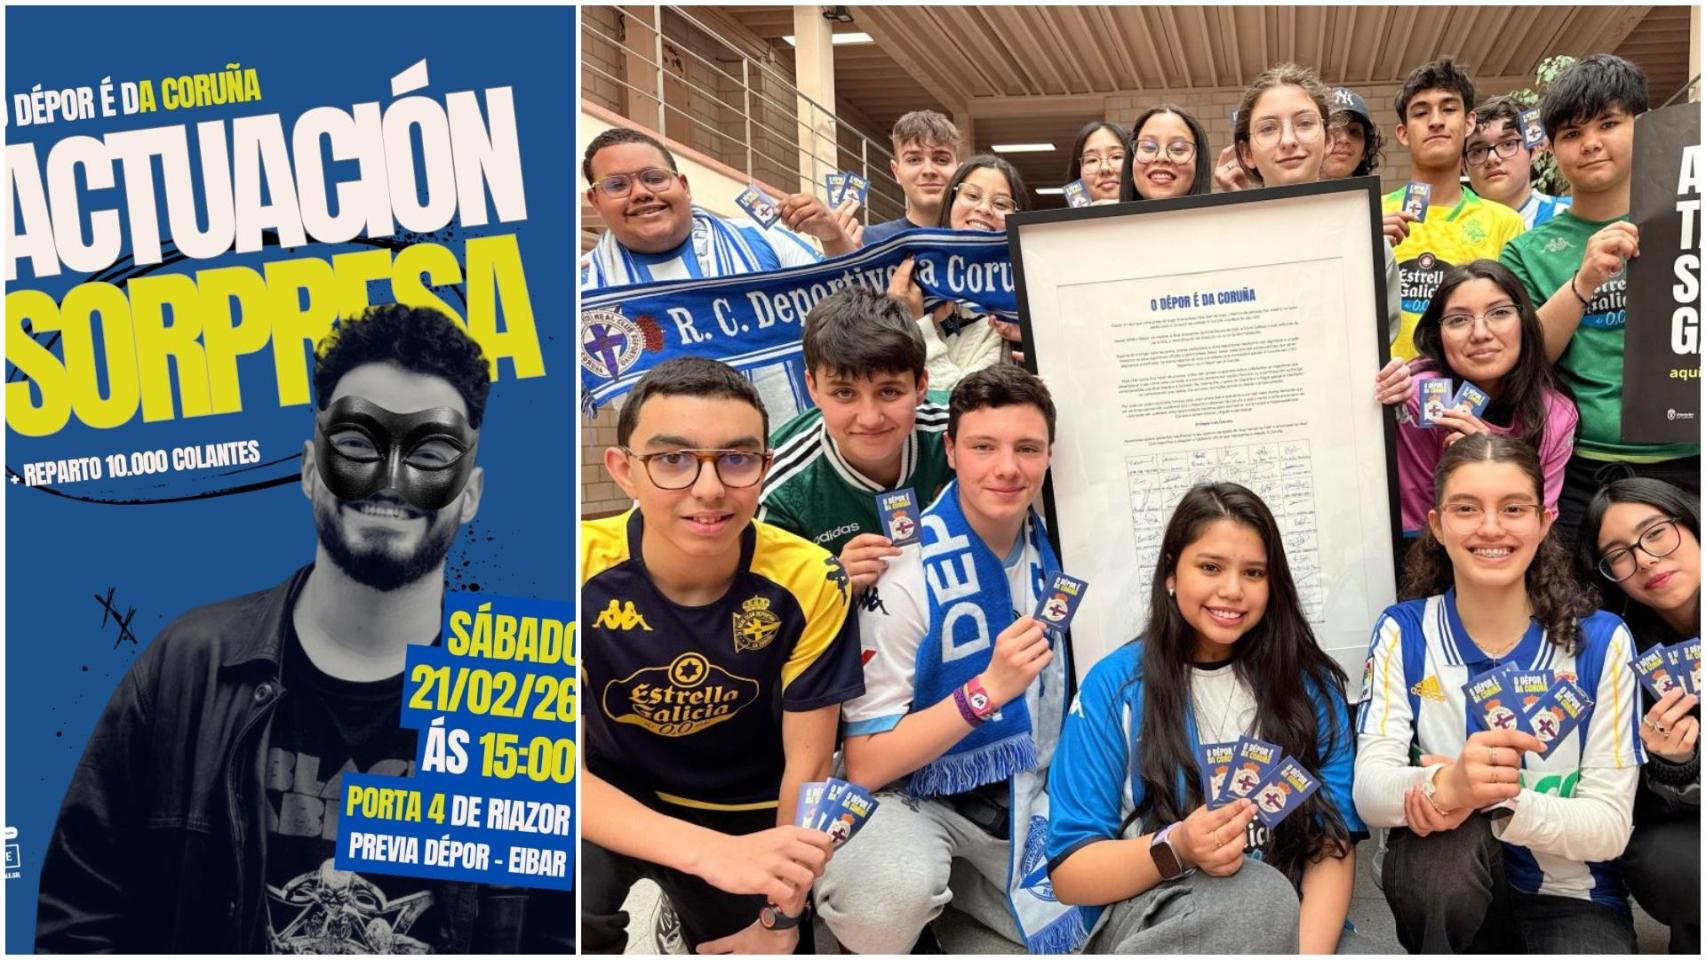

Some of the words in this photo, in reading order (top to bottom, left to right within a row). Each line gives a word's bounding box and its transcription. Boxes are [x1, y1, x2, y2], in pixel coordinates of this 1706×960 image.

[14, 83, 95, 127] DÉPOR
[100, 76, 117, 117] É
[121, 80, 157, 115] DA
[161, 63, 262, 110] CORUÑA
[5, 58, 528, 280] ACTUACIÓN
[947, 255, 1016, 293] Coru
[1399, 268, 1444, 284] Estrell
[1151, 299, 1157, 311] O
[1160, 294, 1191, 310] DÉPOR
[1194, 292, 1200, 307] É
[1202, 293, 1215, 306] DA
[1218, 287, 1256, 304] CORUÑA
[23, 457, 102, 487] REPARTO
[106, 451, 168, 478] 10.000
[172, 440, 261, 471] COLANTES
[813, 523, 860, 544] adidas
[409, 664, 576, 723] 21/02/26
[628, 683, 739, 705] Estrella
[421, 716, 470, 774] ÁS
[479, 732, 576, 784] 15:00
[346, 785, 421, 823] PORTA
[427, 793, 446, 824] 4
[451, 795, 482, 828] DE
[486, 798, 571, 836] RIAZOR
[349, 832, 418, 864] PREVIA
[424, 834, 490, 871] DÉPOR
[508, 846, 567, 877] EIBAR
